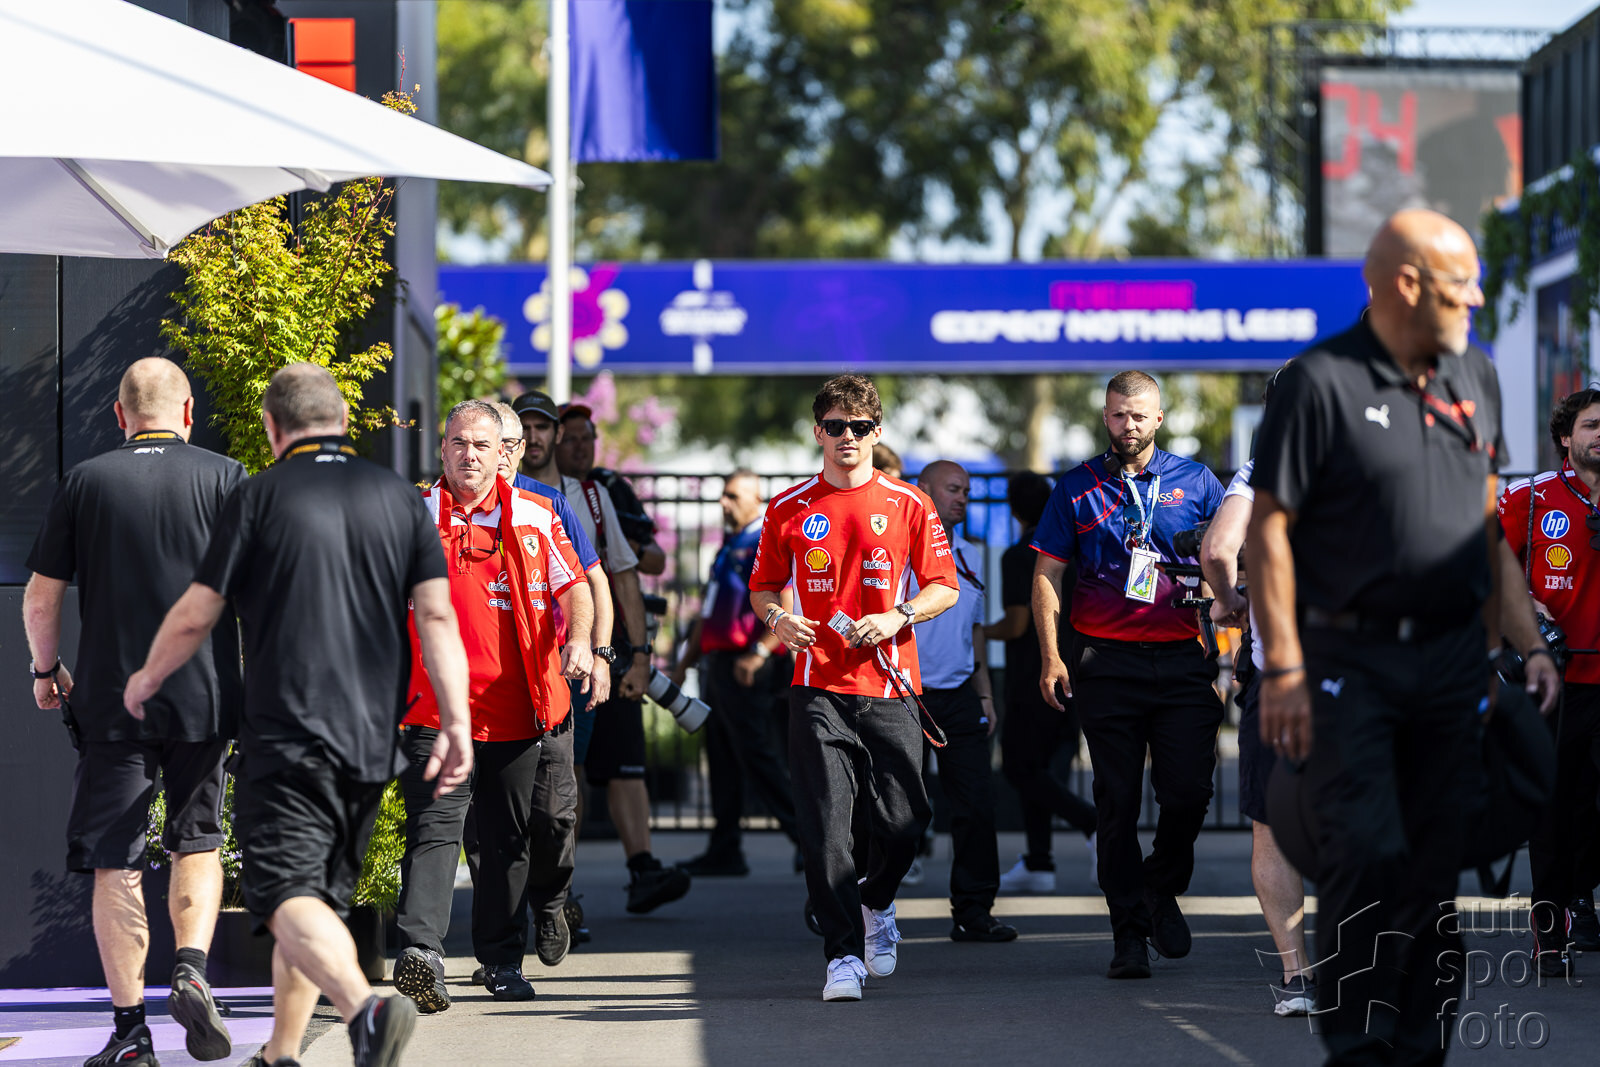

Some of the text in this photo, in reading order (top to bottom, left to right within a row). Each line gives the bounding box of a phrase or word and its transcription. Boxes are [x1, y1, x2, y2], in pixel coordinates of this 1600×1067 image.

[1065, 310, 1223, 341] NOTHING
[1226, 310, 1317, 341] LESS
[587, 487, 601, 524] Canon
[806, 514, 827, 540] hp
[1545, 511, 1566, 538] hp
[807, 579, 834, 592] IBM
[1544, 575, 1573, 590] IBM
